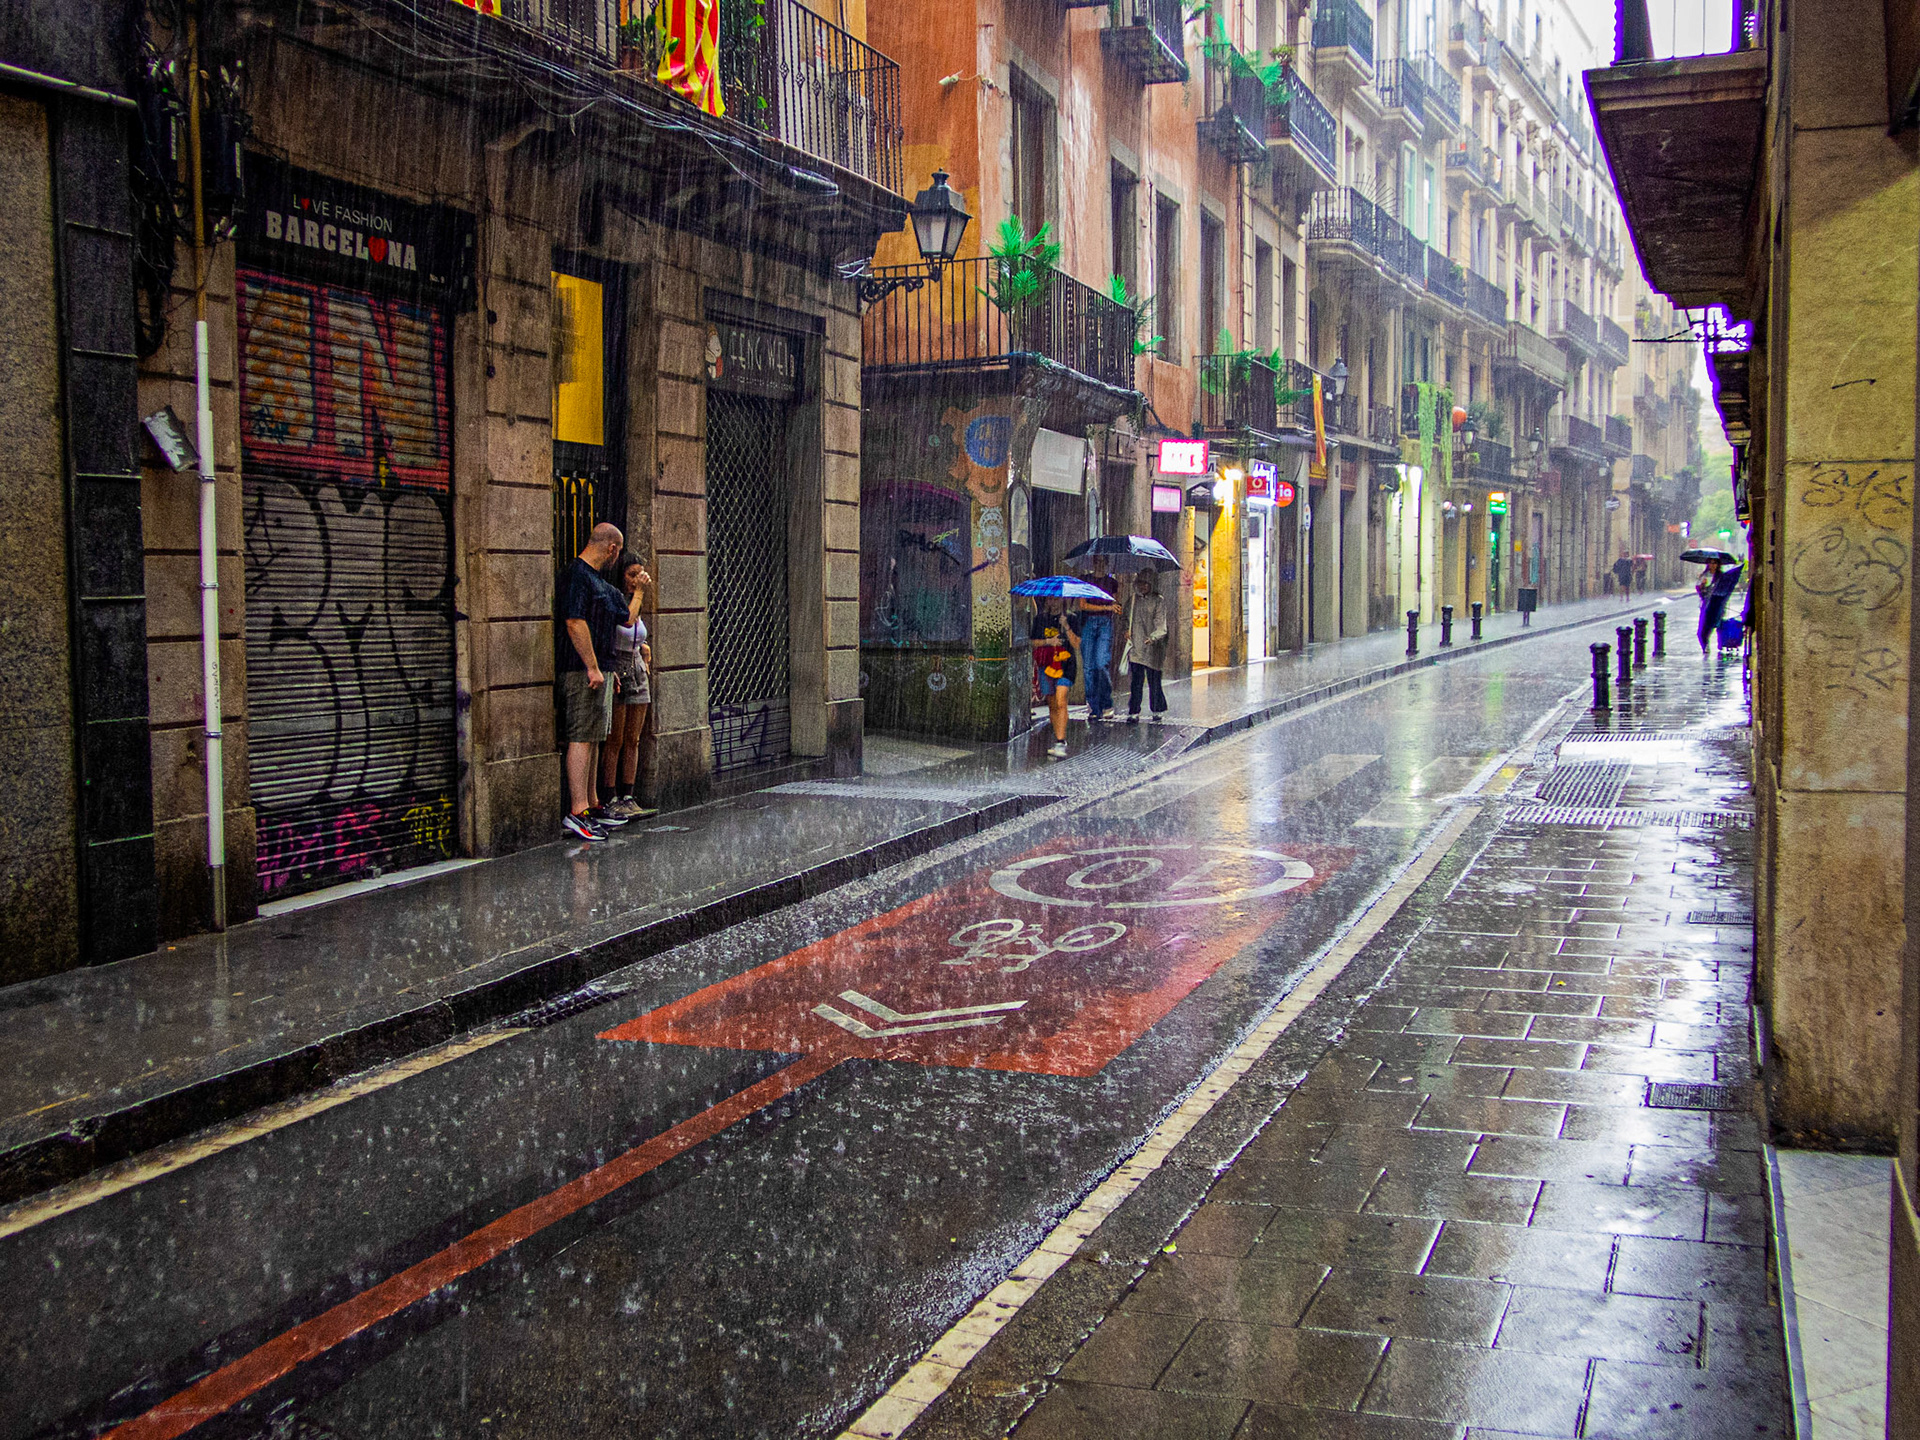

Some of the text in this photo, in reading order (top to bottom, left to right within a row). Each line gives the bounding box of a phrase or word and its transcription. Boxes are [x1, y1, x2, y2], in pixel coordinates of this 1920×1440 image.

[335, 205, 393, 233] FASHION
[266, 209, 417, 271] BARCELONA
[1277, 484, 1292, 497] ia
